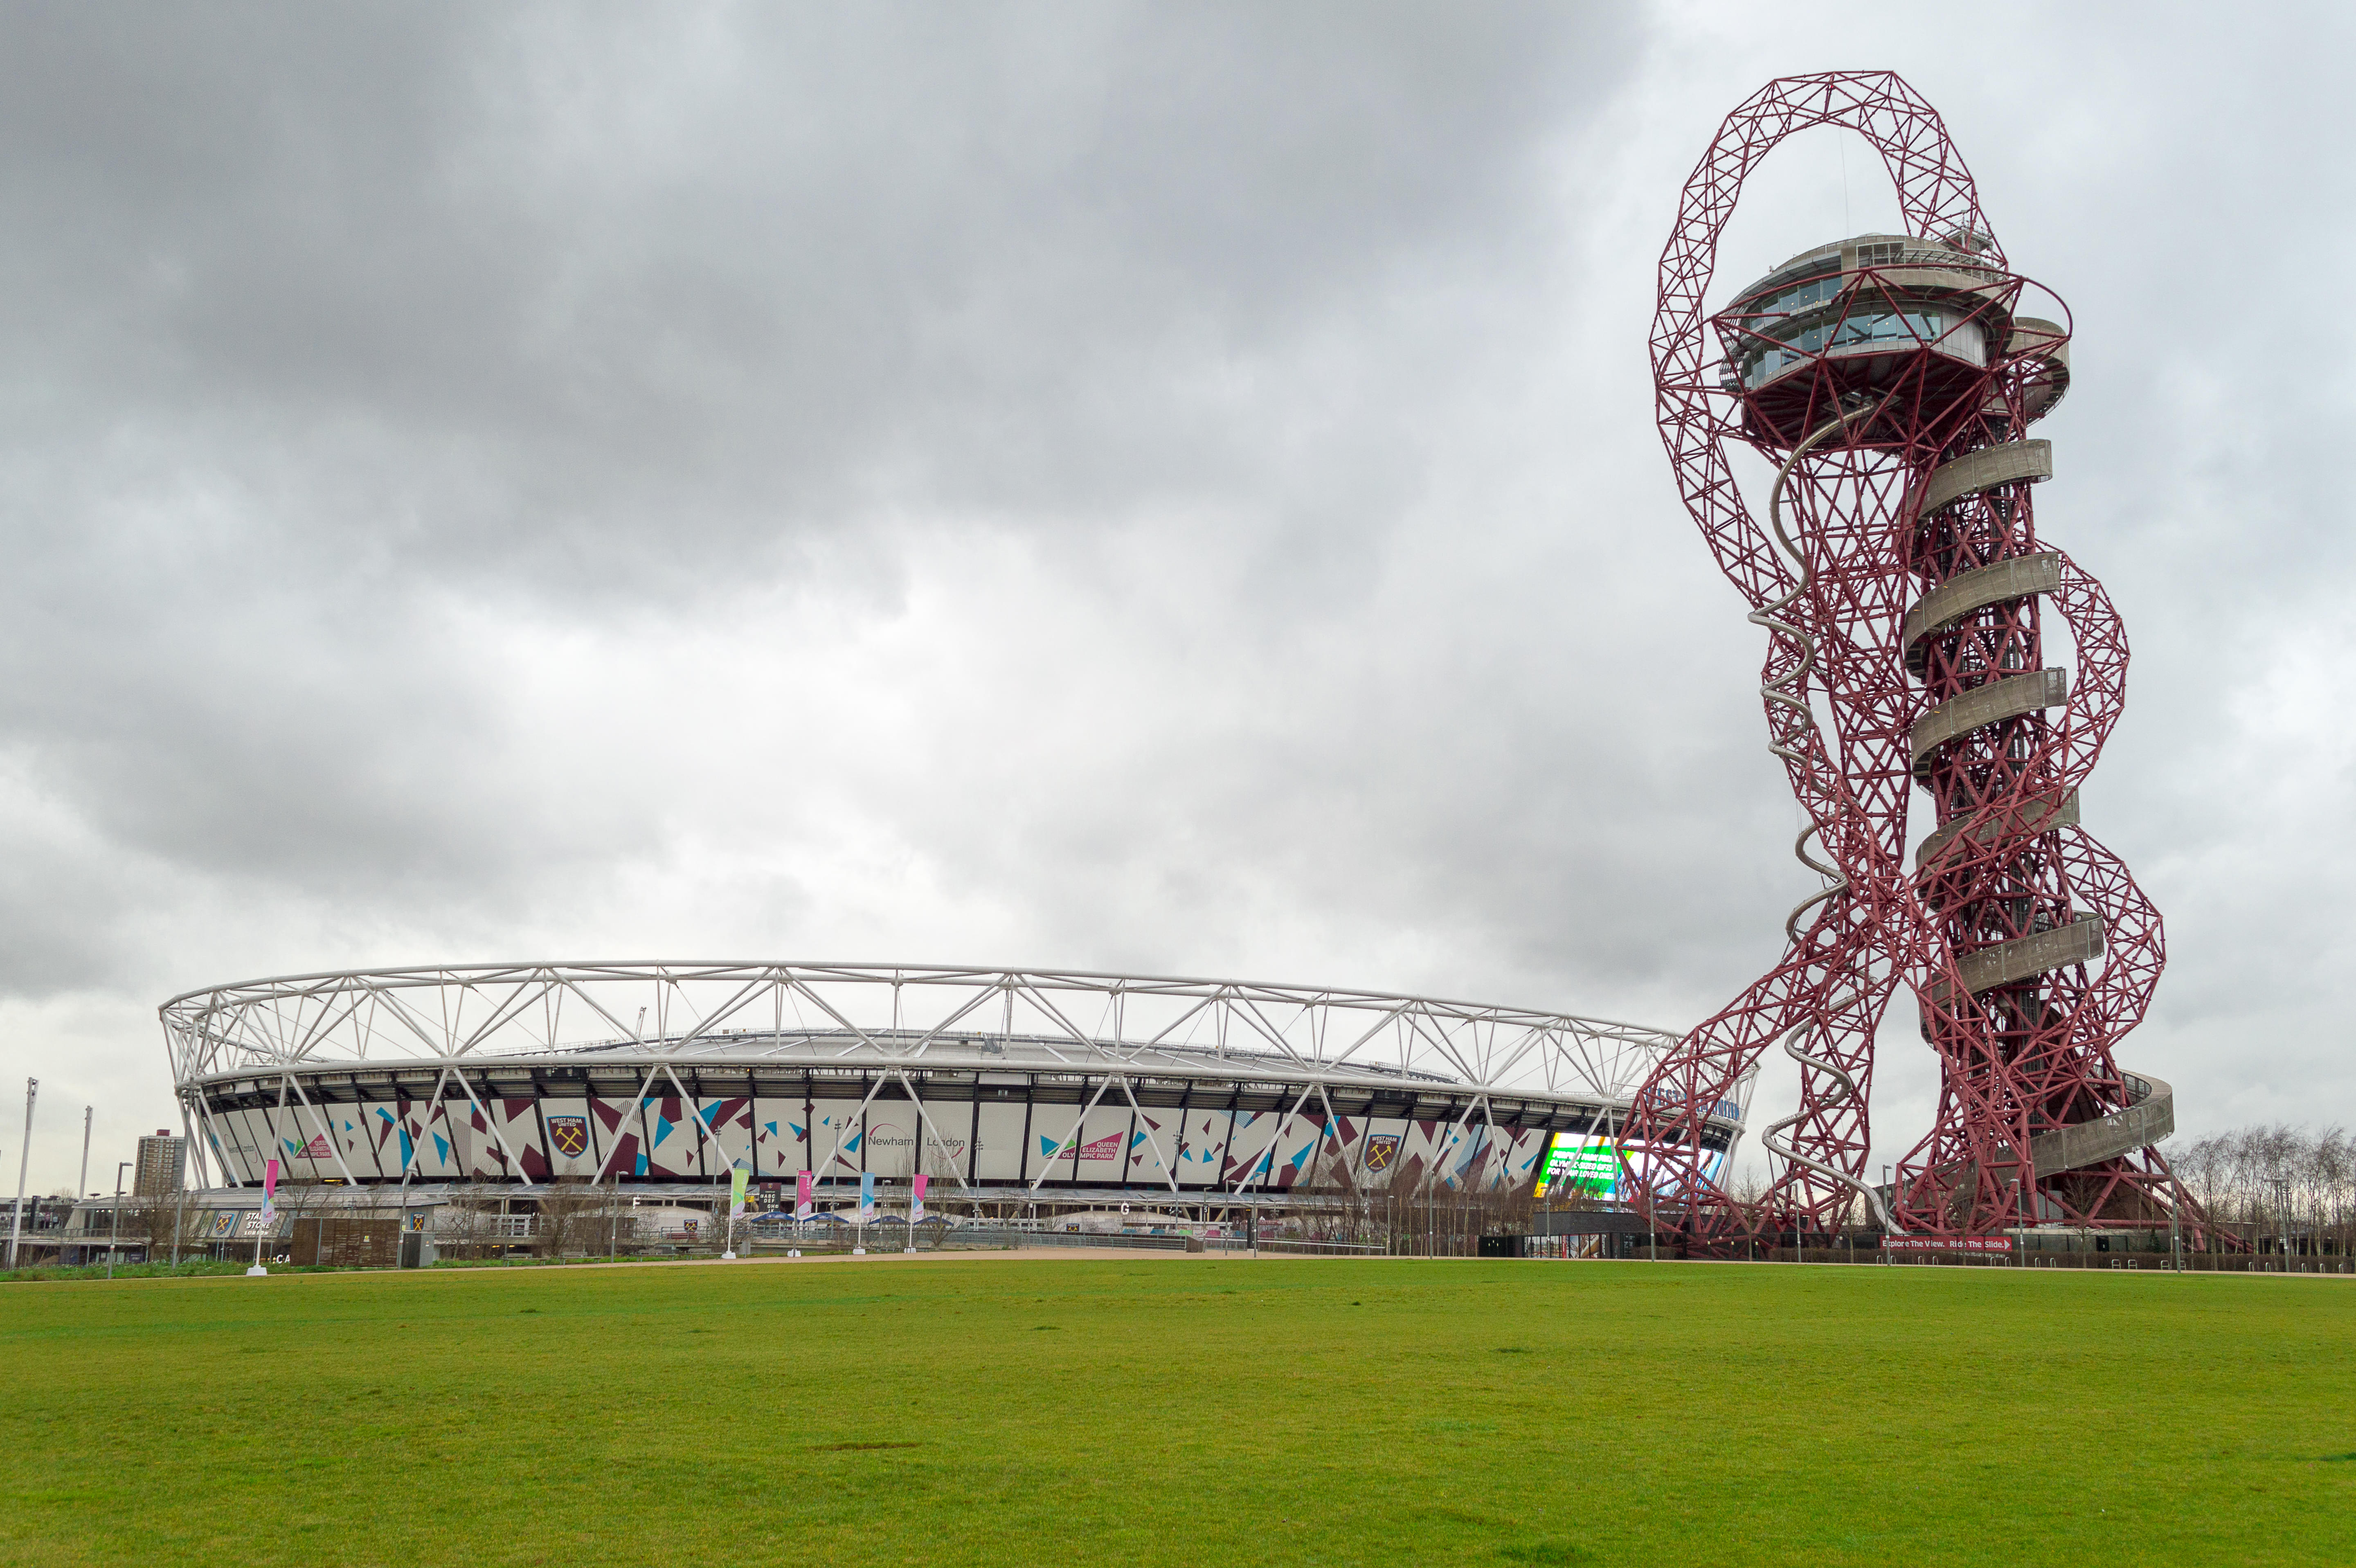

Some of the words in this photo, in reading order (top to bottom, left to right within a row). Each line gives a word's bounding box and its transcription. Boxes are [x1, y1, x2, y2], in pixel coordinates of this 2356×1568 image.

[868, 1136, 914, 1146] Newham
[1550, 1159, 1597, 1170] OLYMIC-SIZED
[1597, 1163, 1613, 1172] GIFTS
[1546, 1167, 1561, 1175] FOR
[1578, 1170, 1599, 1179] LOVED
[633, 1197, 641, 1210] F
[1121, 1203, 1130, 1215] G
